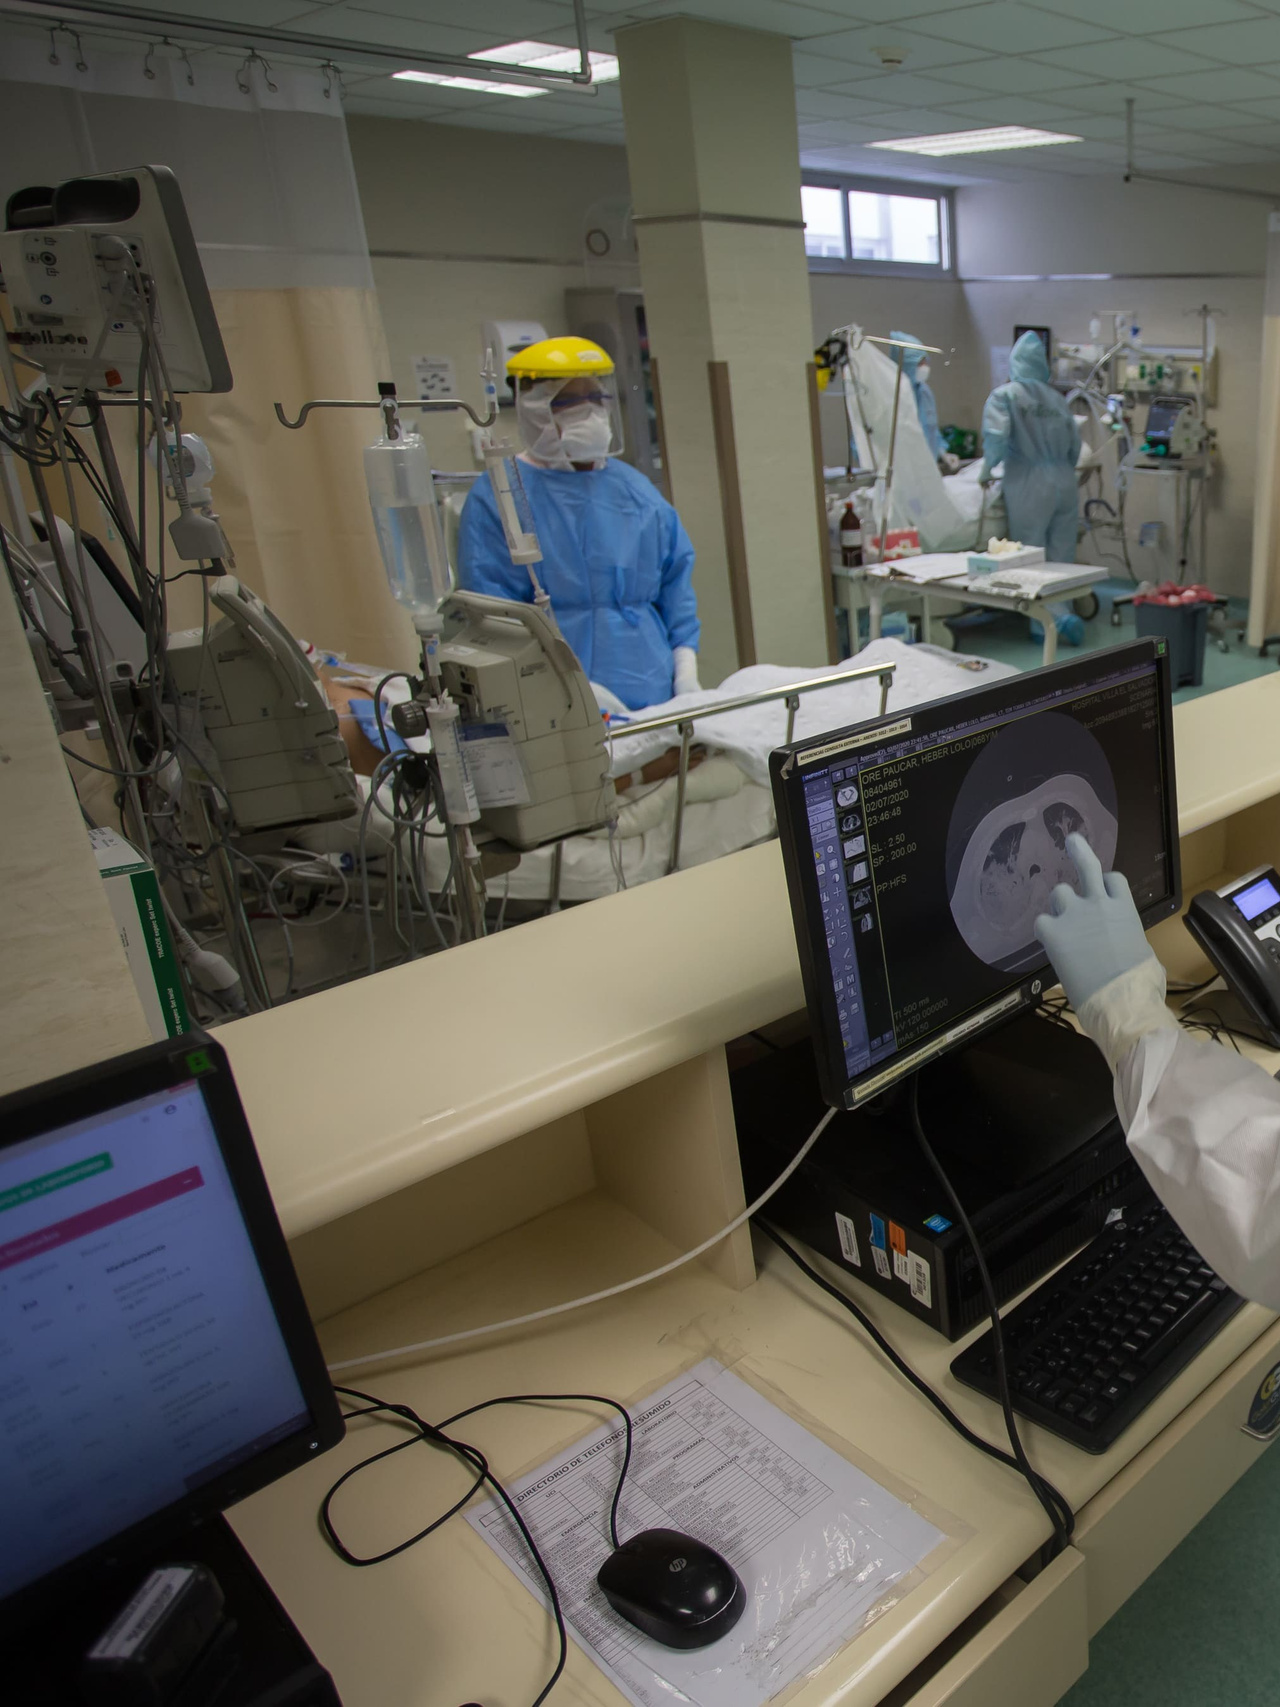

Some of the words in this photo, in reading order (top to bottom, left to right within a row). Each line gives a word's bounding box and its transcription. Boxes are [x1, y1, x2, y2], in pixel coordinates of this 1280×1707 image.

[862, 771, 881, 785] ORE
[921, 748, 949, 764] HEBER
[864, 778, 902, 798] 08404961
[866, 789, 909, 812] 02/07/2020
[868, 806, 901, 827] 23:46:48
[872, 845, 882, 854] SL
[888, 833, 905, 848] 2.50
[873, 856, 884, 867] SP
[891, 842, 917, 860] 200.00
[672, 1436, 705, 1460] PROGRAMAS
[516, 1465, 570, 1502] DIRECTORIO
[569, 1457, 583, 1467] DE
[691, 1454, 740, 1489] ADMINISTRATIVOS
[545, 1489, 556, 1497] UCI
[560, 1509, 598, 1536] EMERGENCIA
